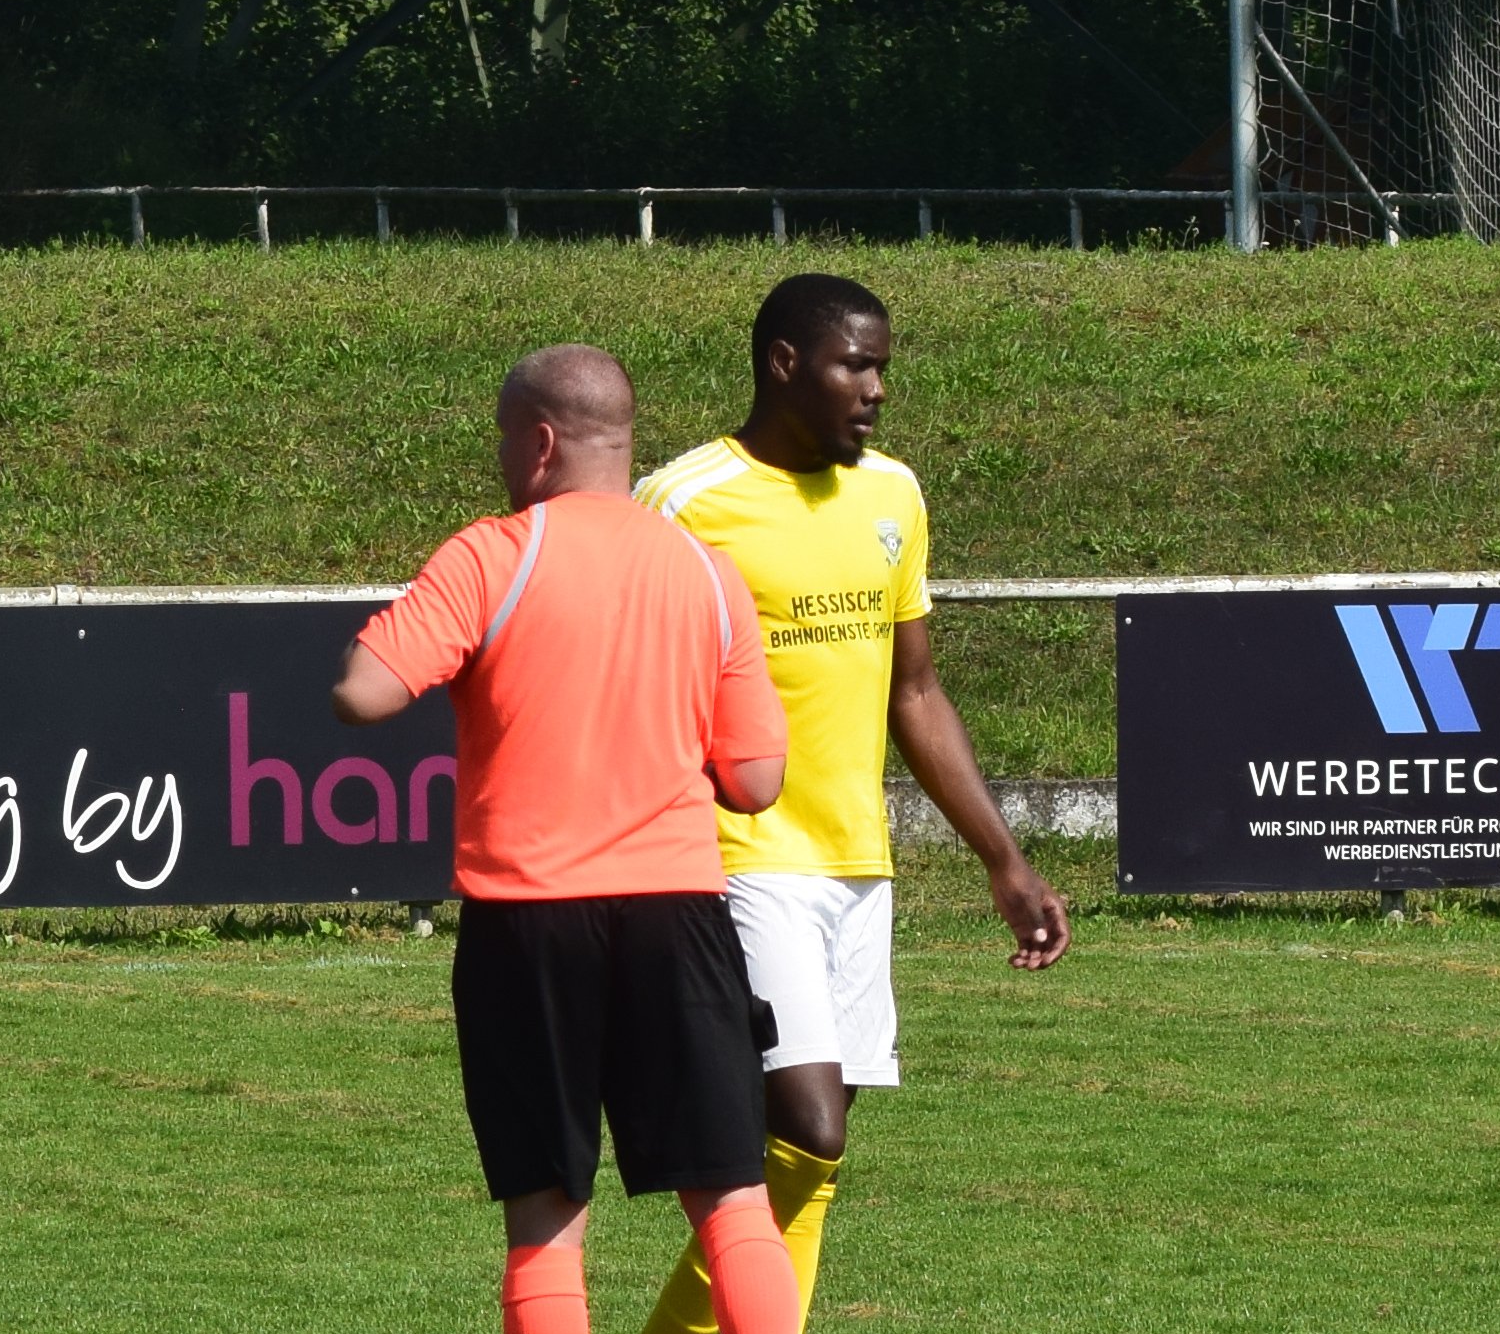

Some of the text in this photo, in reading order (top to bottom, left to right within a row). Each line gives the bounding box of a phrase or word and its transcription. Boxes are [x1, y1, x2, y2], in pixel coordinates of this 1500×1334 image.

[792, 590, 883, 618] HESSISCHE
[770, 622, 870, 648] BAHNDIENSTE
[63, 748, 183, 890] by
[1249, 821, 1282, 837] WIR
[1285, 820, 1326, 836] SIND
[1330, 820, 1359, 836] IHR
[1363, 819, 1437, 835] PARTNER
[1442, 816, 1474, 834] FÜR
